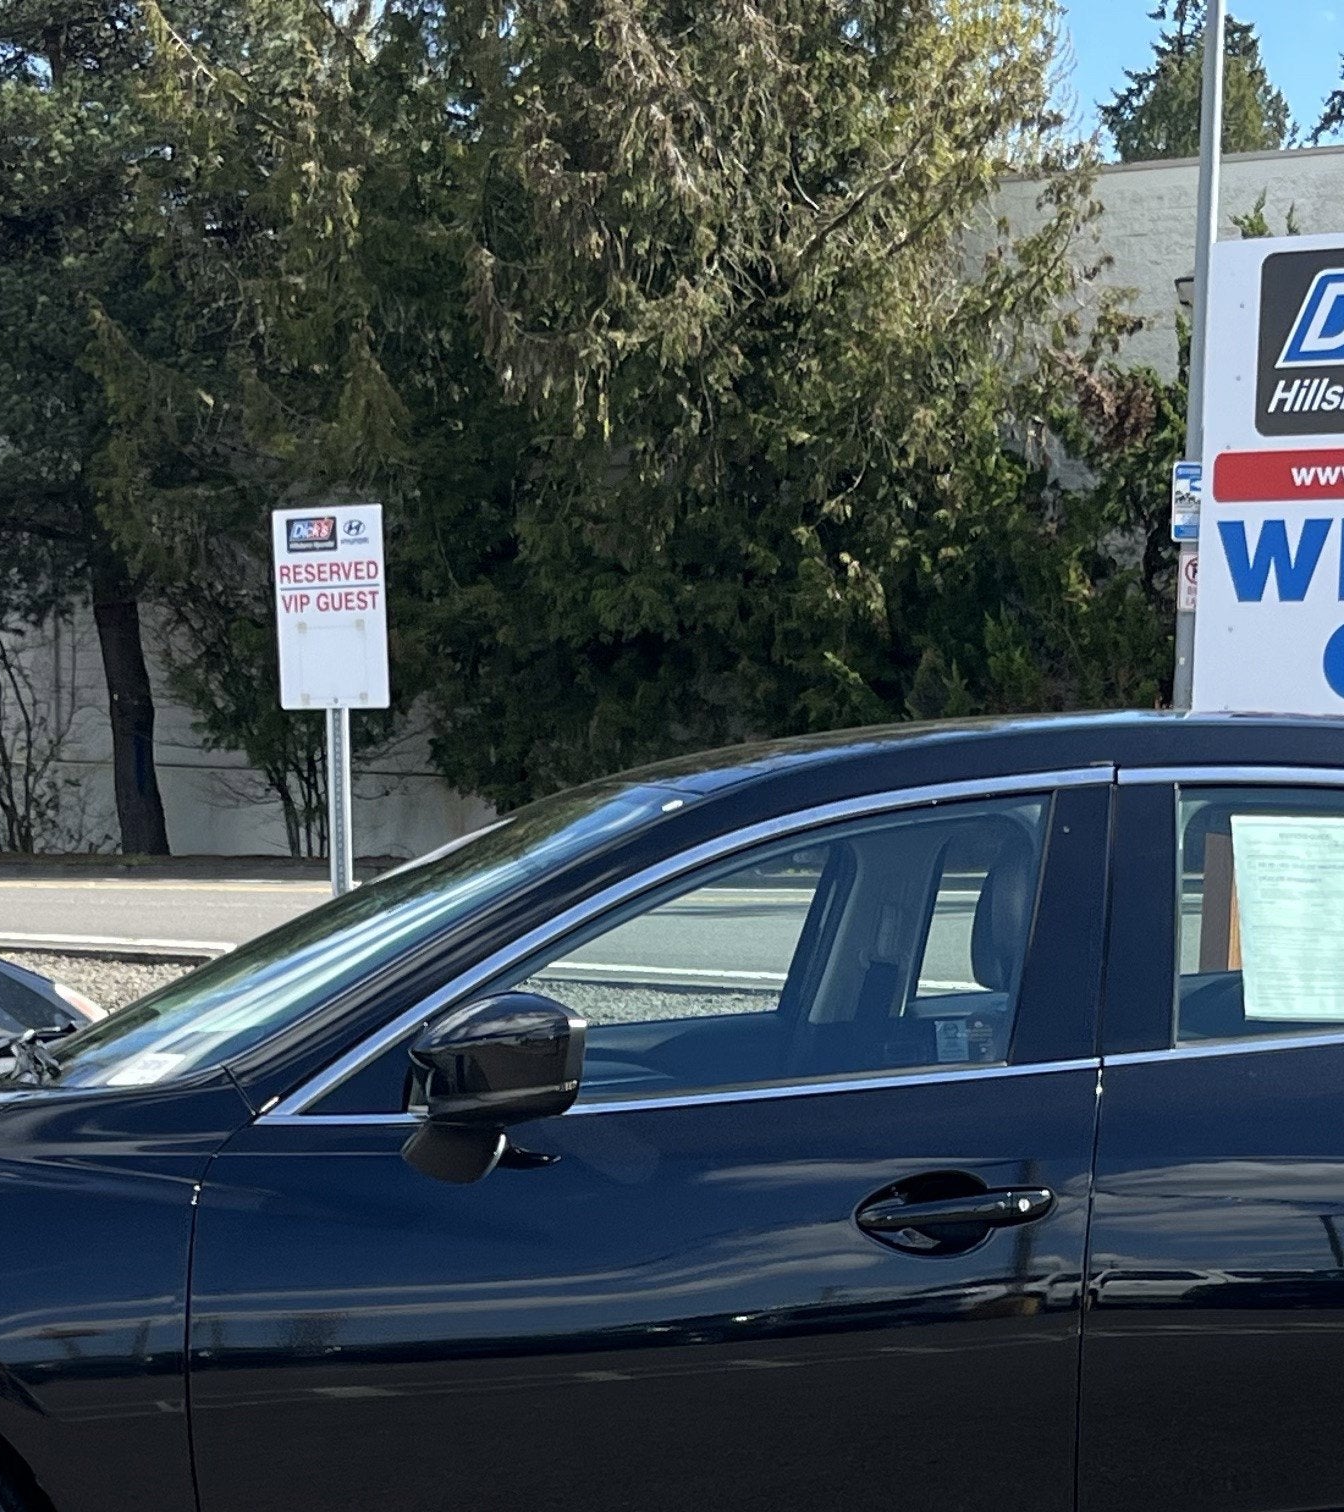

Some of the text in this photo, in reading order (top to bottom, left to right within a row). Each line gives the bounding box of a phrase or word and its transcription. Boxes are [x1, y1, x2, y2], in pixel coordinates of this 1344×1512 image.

[279, 560, 379, 584] RESERVED
[282, 591, 380, 613] VIP GUEST
